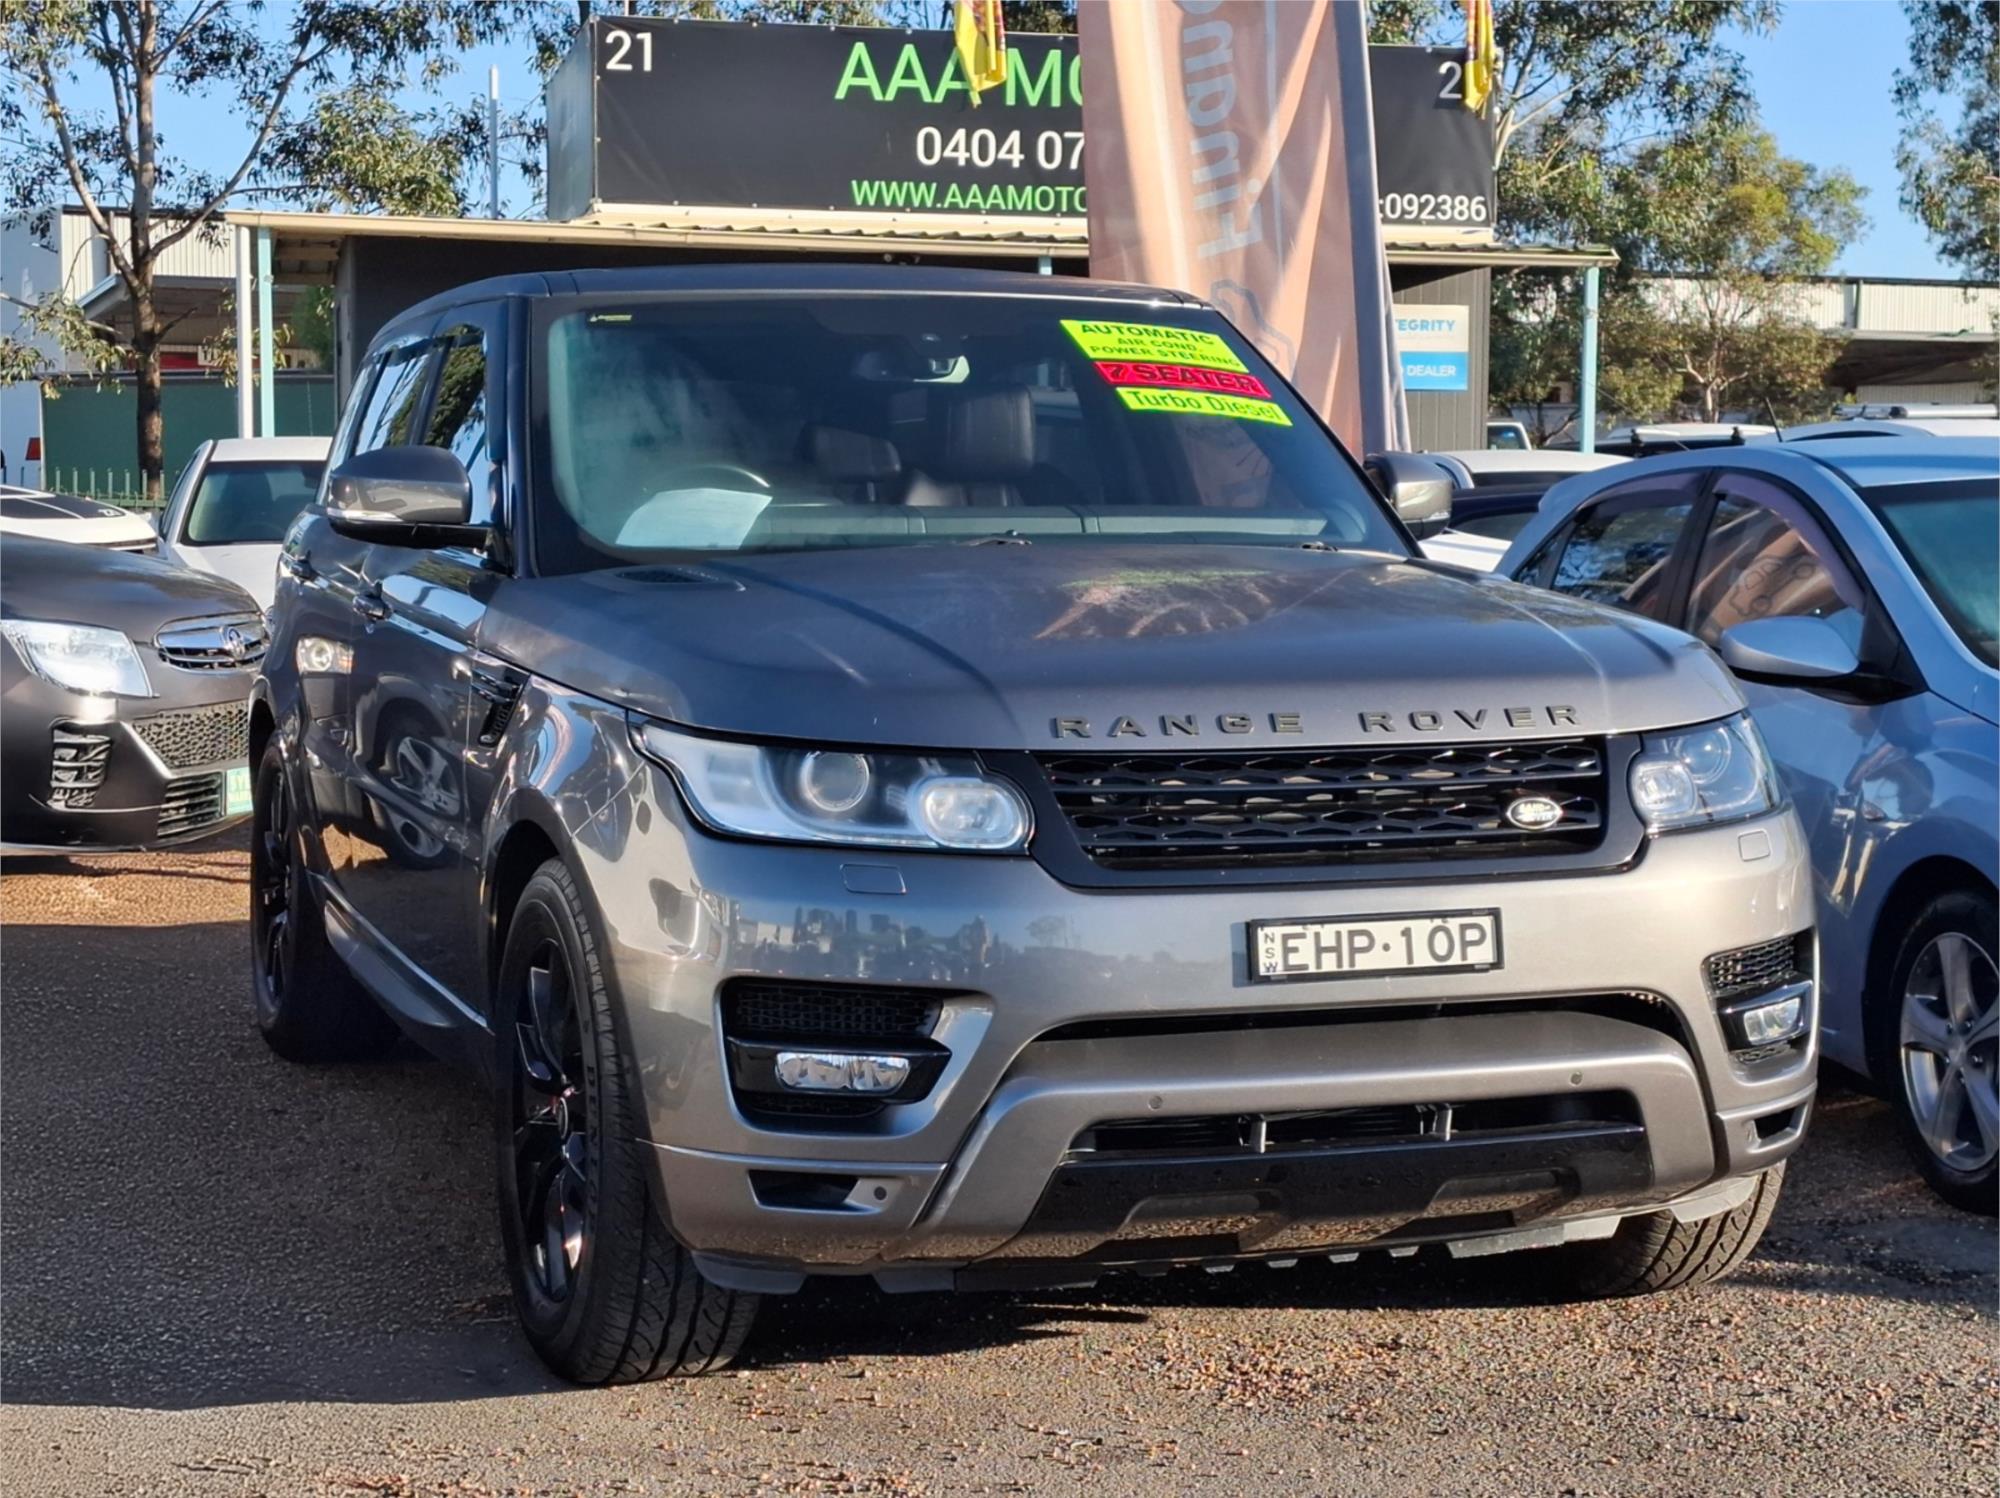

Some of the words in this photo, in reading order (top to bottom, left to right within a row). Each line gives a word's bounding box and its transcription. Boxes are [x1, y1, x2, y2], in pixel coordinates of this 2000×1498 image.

[605, 31, 653, 72] 21
[834, 42, 982, 106] AAA
[1438, 61, 1463, 99] 2
[916, 127, 1025, 168] 0404
[1037, 130, 1086, 171] 07
[1081, 323, 1215, 346] AUTOMATIC
[1117, 337, 1145, 347] AIR
[1089, 344, 1154, 356] POWER
[1157, 349, 1240, 368] STEERING
[1407, 365, 1456, 377] DEALER
[1102, 363, 1125, 379] 7
[1132, 364, 1262, 393] SEATER
[1130, 391, 1202, 410] Turbo
[1204, 395, 1283, 421] Diesel
[1052, 712, 1304, 739] RANGE
[1358, 705, 1582, 733] ROVER
